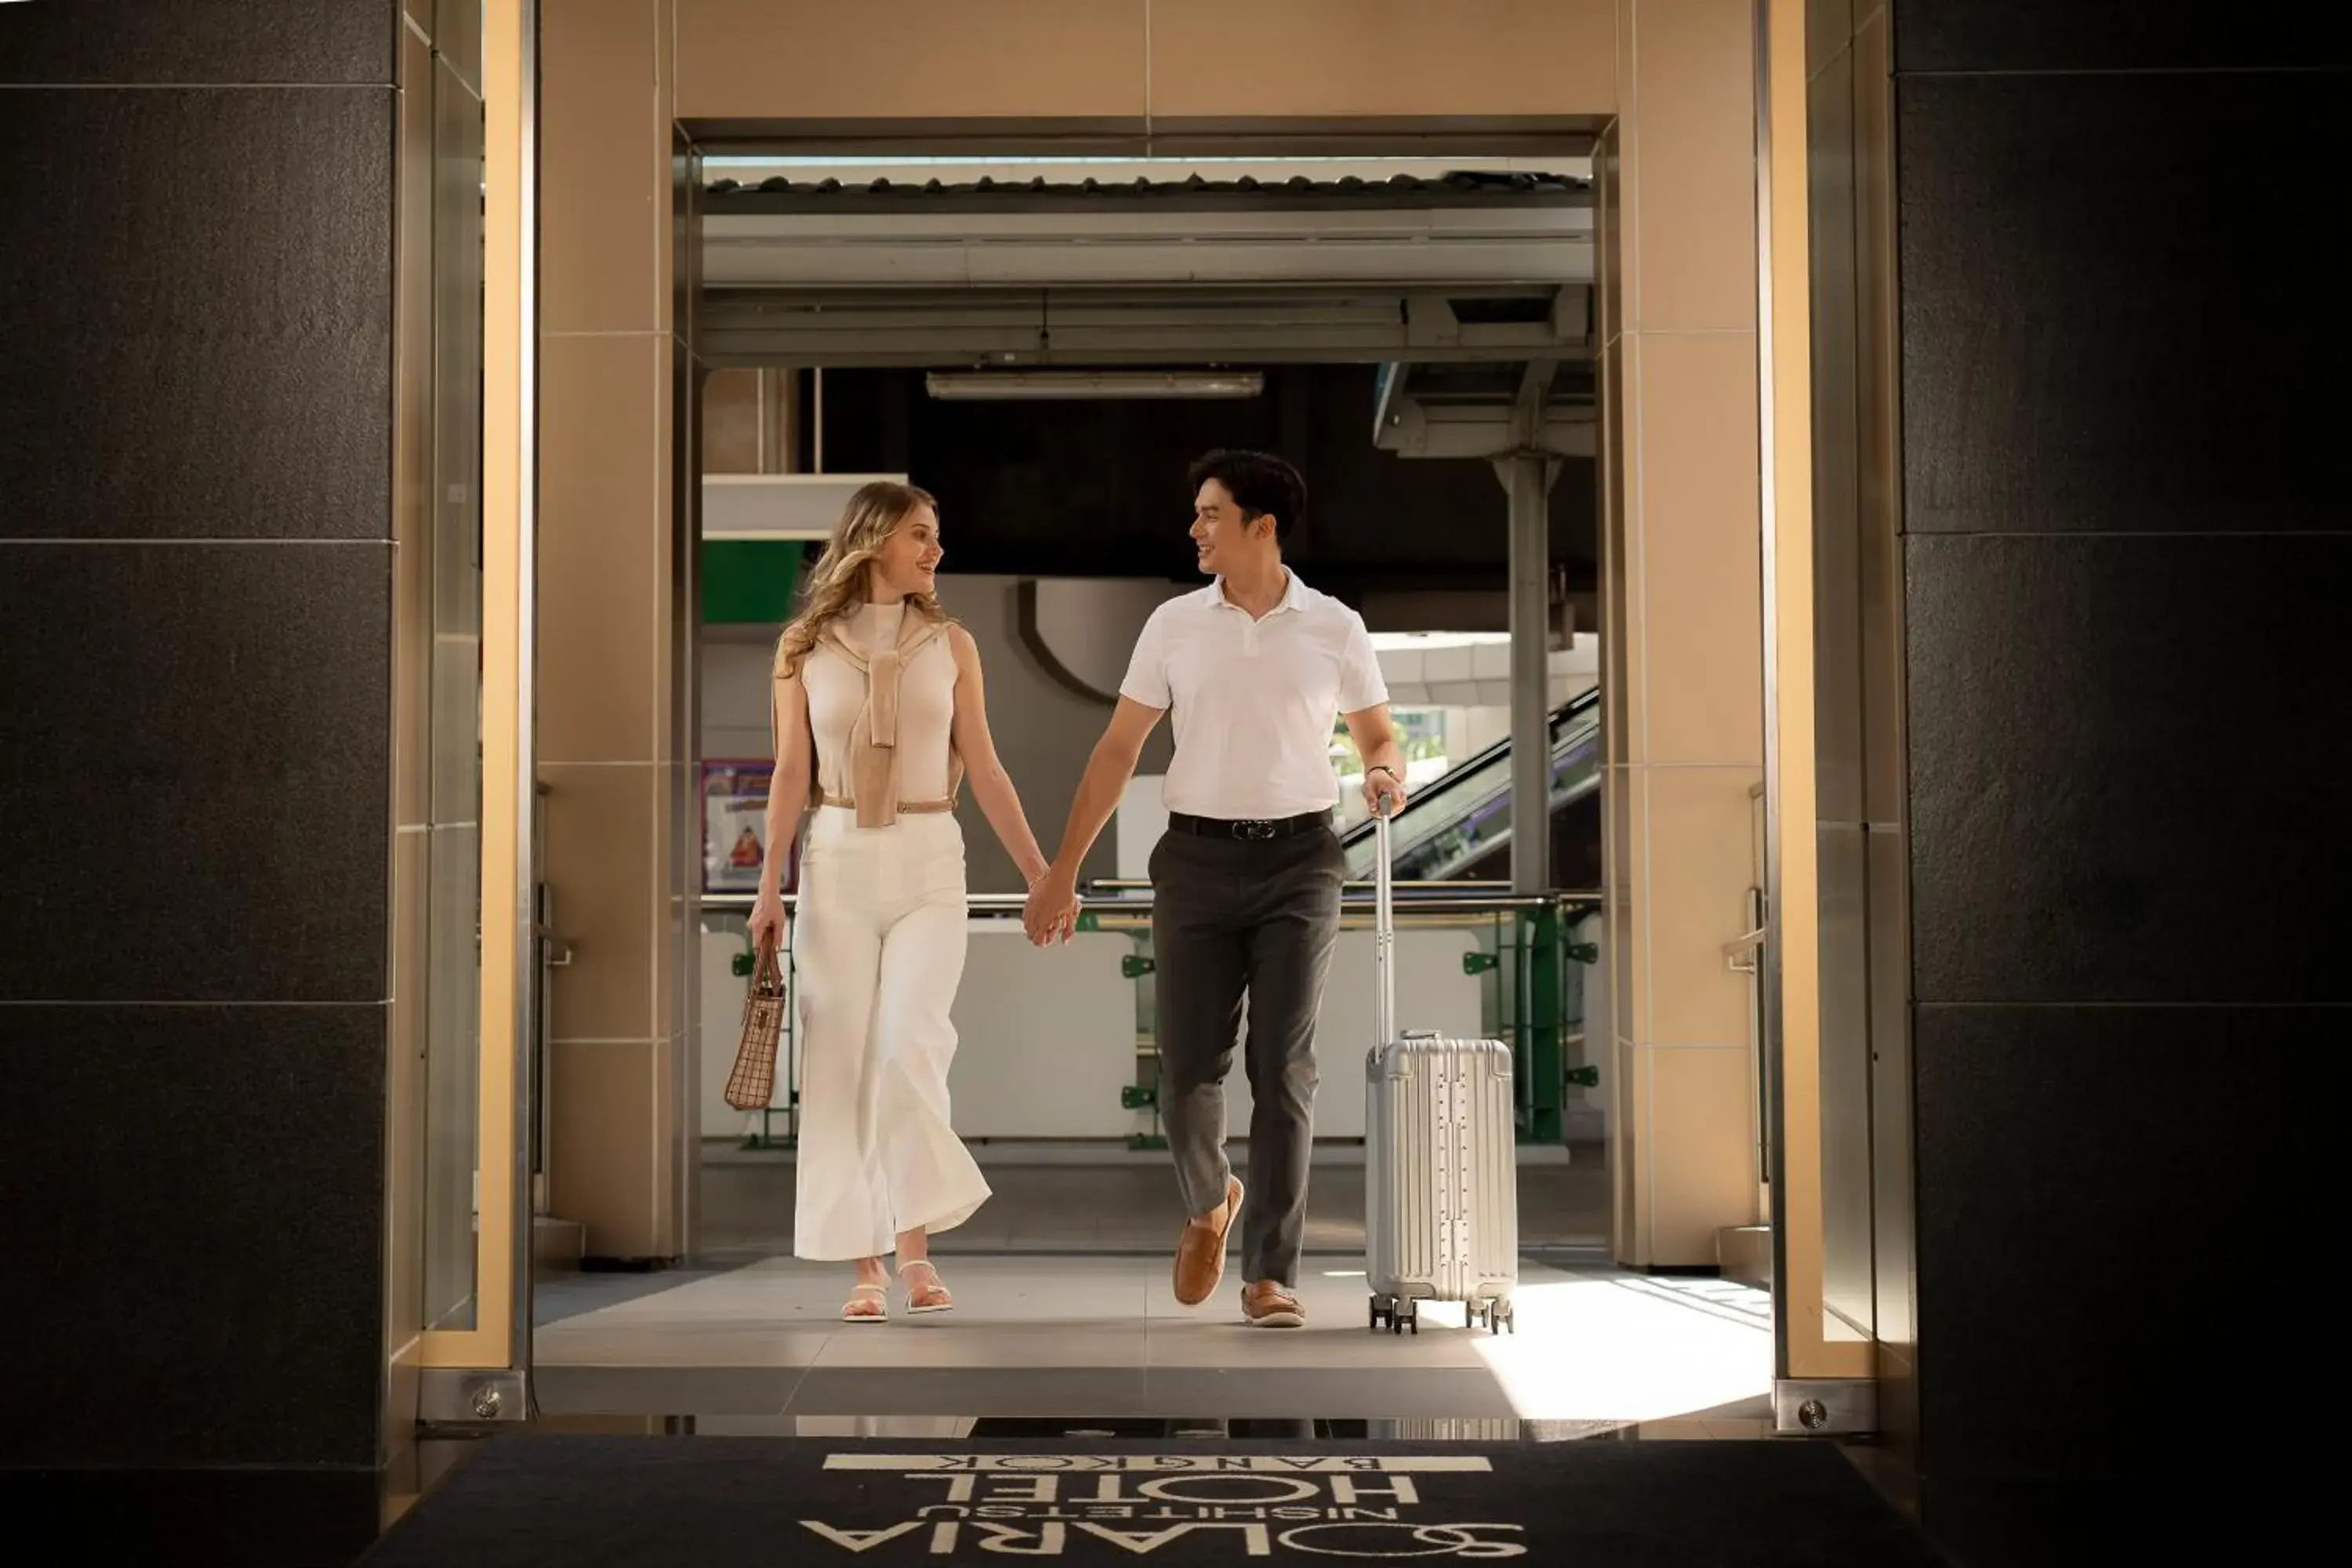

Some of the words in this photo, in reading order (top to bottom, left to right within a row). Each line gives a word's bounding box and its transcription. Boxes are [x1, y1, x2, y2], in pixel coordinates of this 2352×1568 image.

[938, 1455, 1381, 1470] BANGKOK
[904, 1473, 1420, 1504] HOTEL
[917, 1505, 1399, 1519] NISHITETSU
[798, 1519, 1528, 1558] SOLARIA
